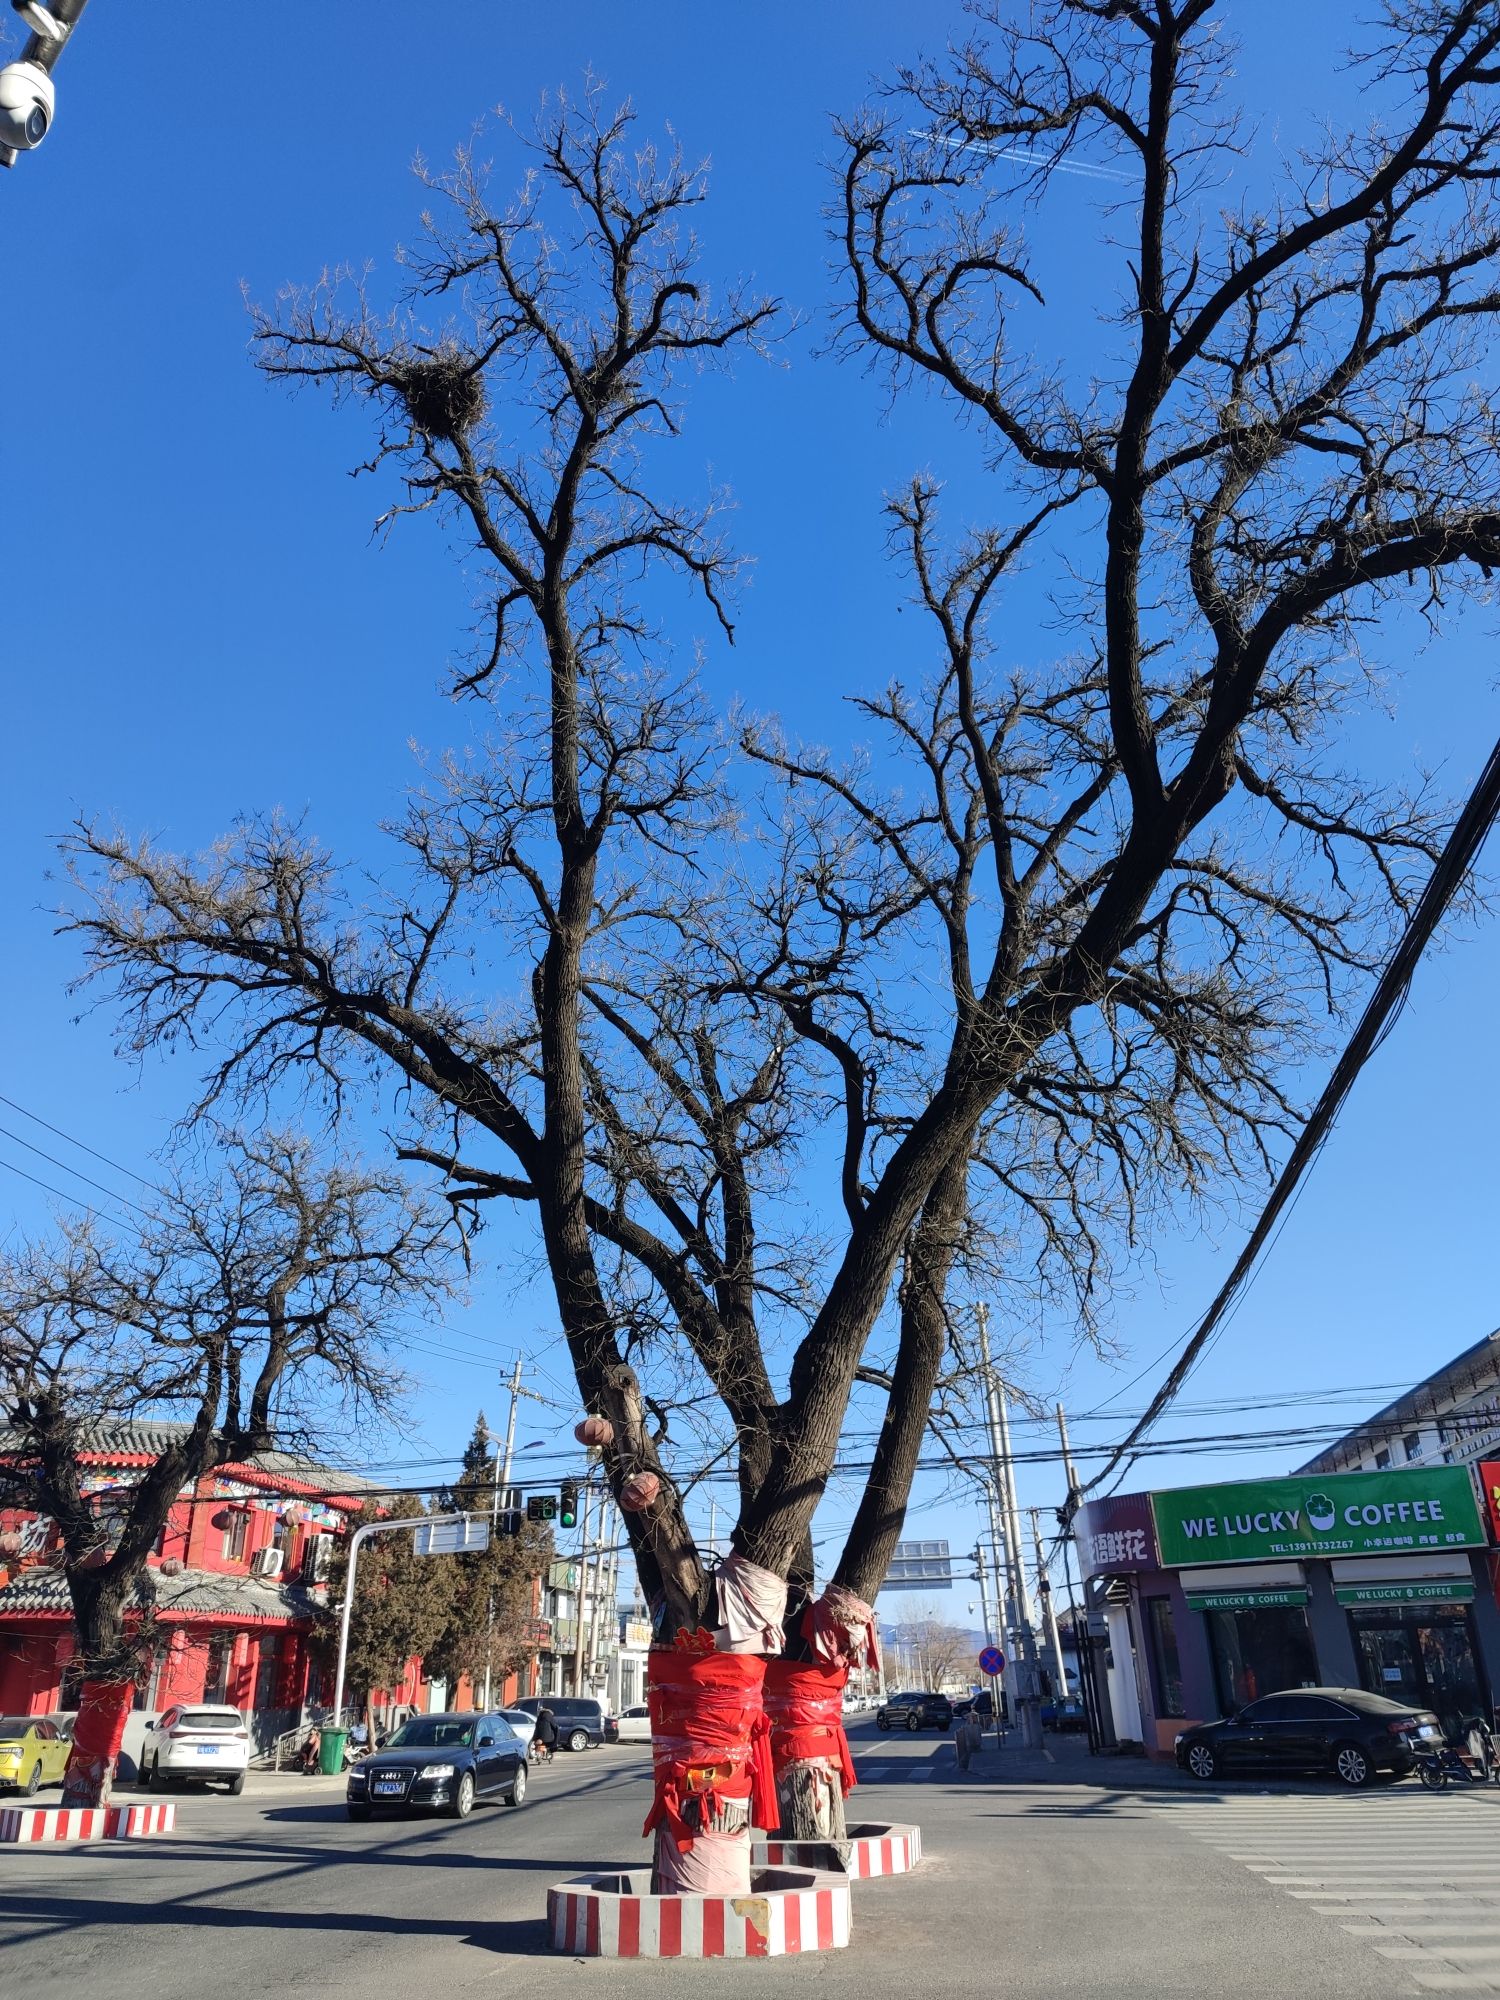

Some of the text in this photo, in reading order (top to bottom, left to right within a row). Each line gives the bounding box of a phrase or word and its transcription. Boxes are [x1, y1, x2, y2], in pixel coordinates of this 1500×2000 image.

[1181, 1500, 1445, 1538] WE LUCKY COFFEE
[1418, 1587, 1453, 1597] COFFEE
[1258, 1595, 1289, 1604] COFFEE
